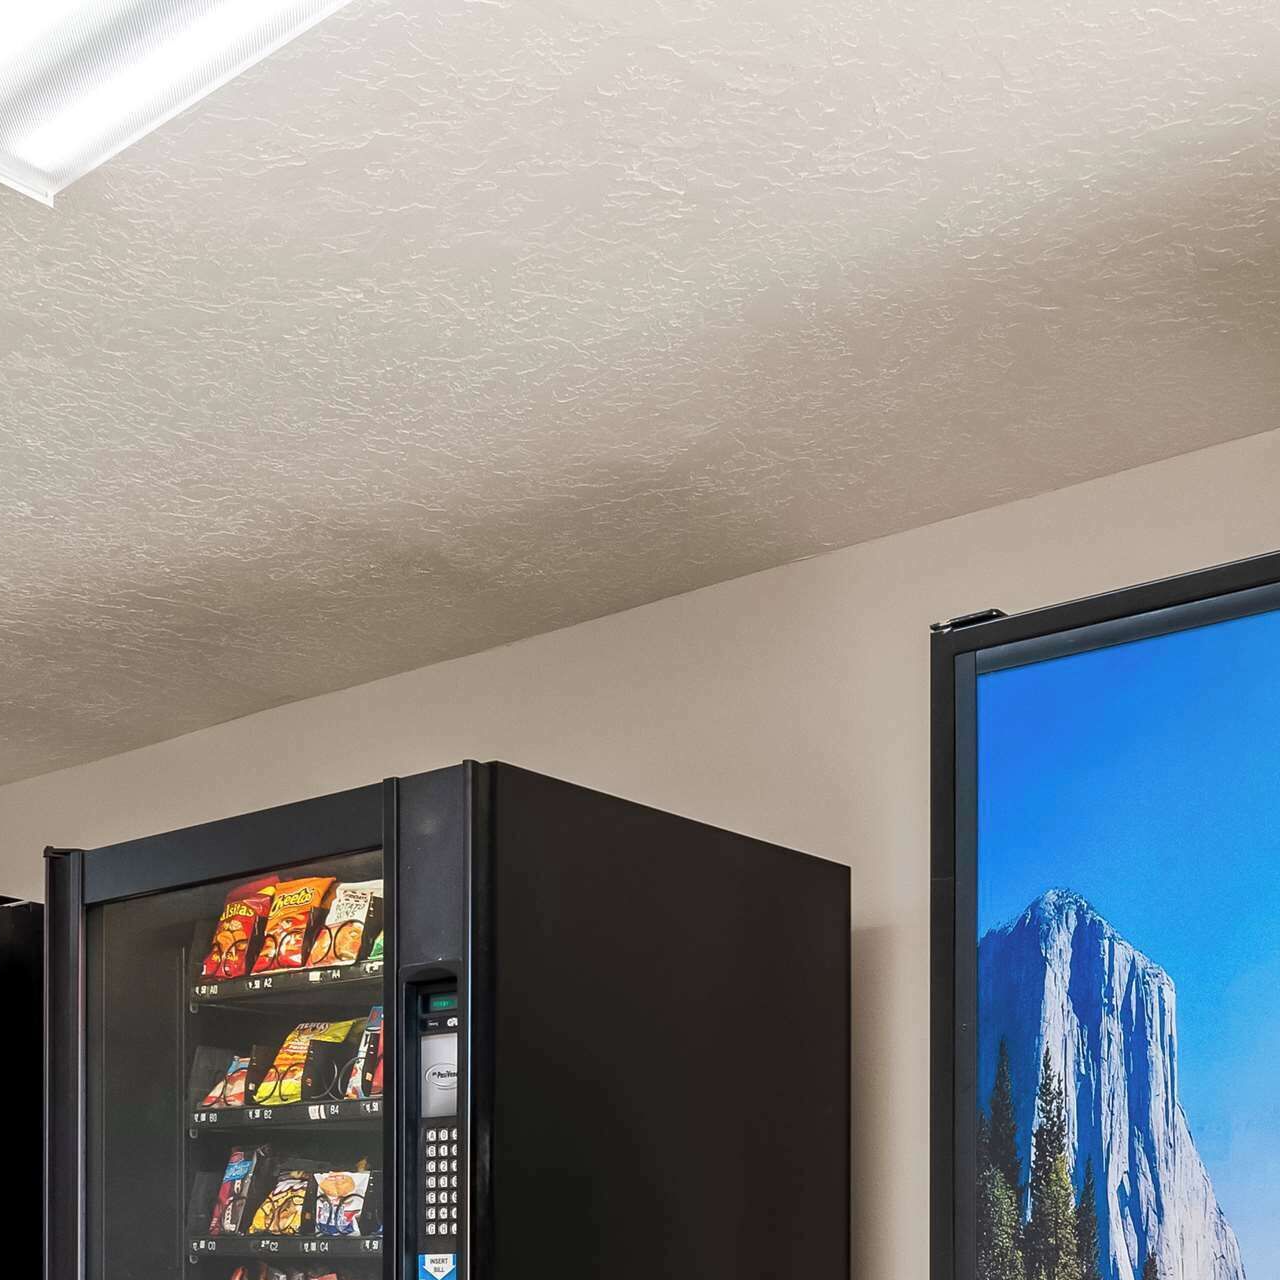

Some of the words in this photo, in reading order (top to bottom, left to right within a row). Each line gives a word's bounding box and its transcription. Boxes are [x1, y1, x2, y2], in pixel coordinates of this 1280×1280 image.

[269, 887, 315, 917] Cheetos
[263, 978, 272, 987] A2
[270, 1242, 279, 1251] C2
[319, 1242, 328, 1251] C4
[430, 1257, 448, 1265] INSERT
